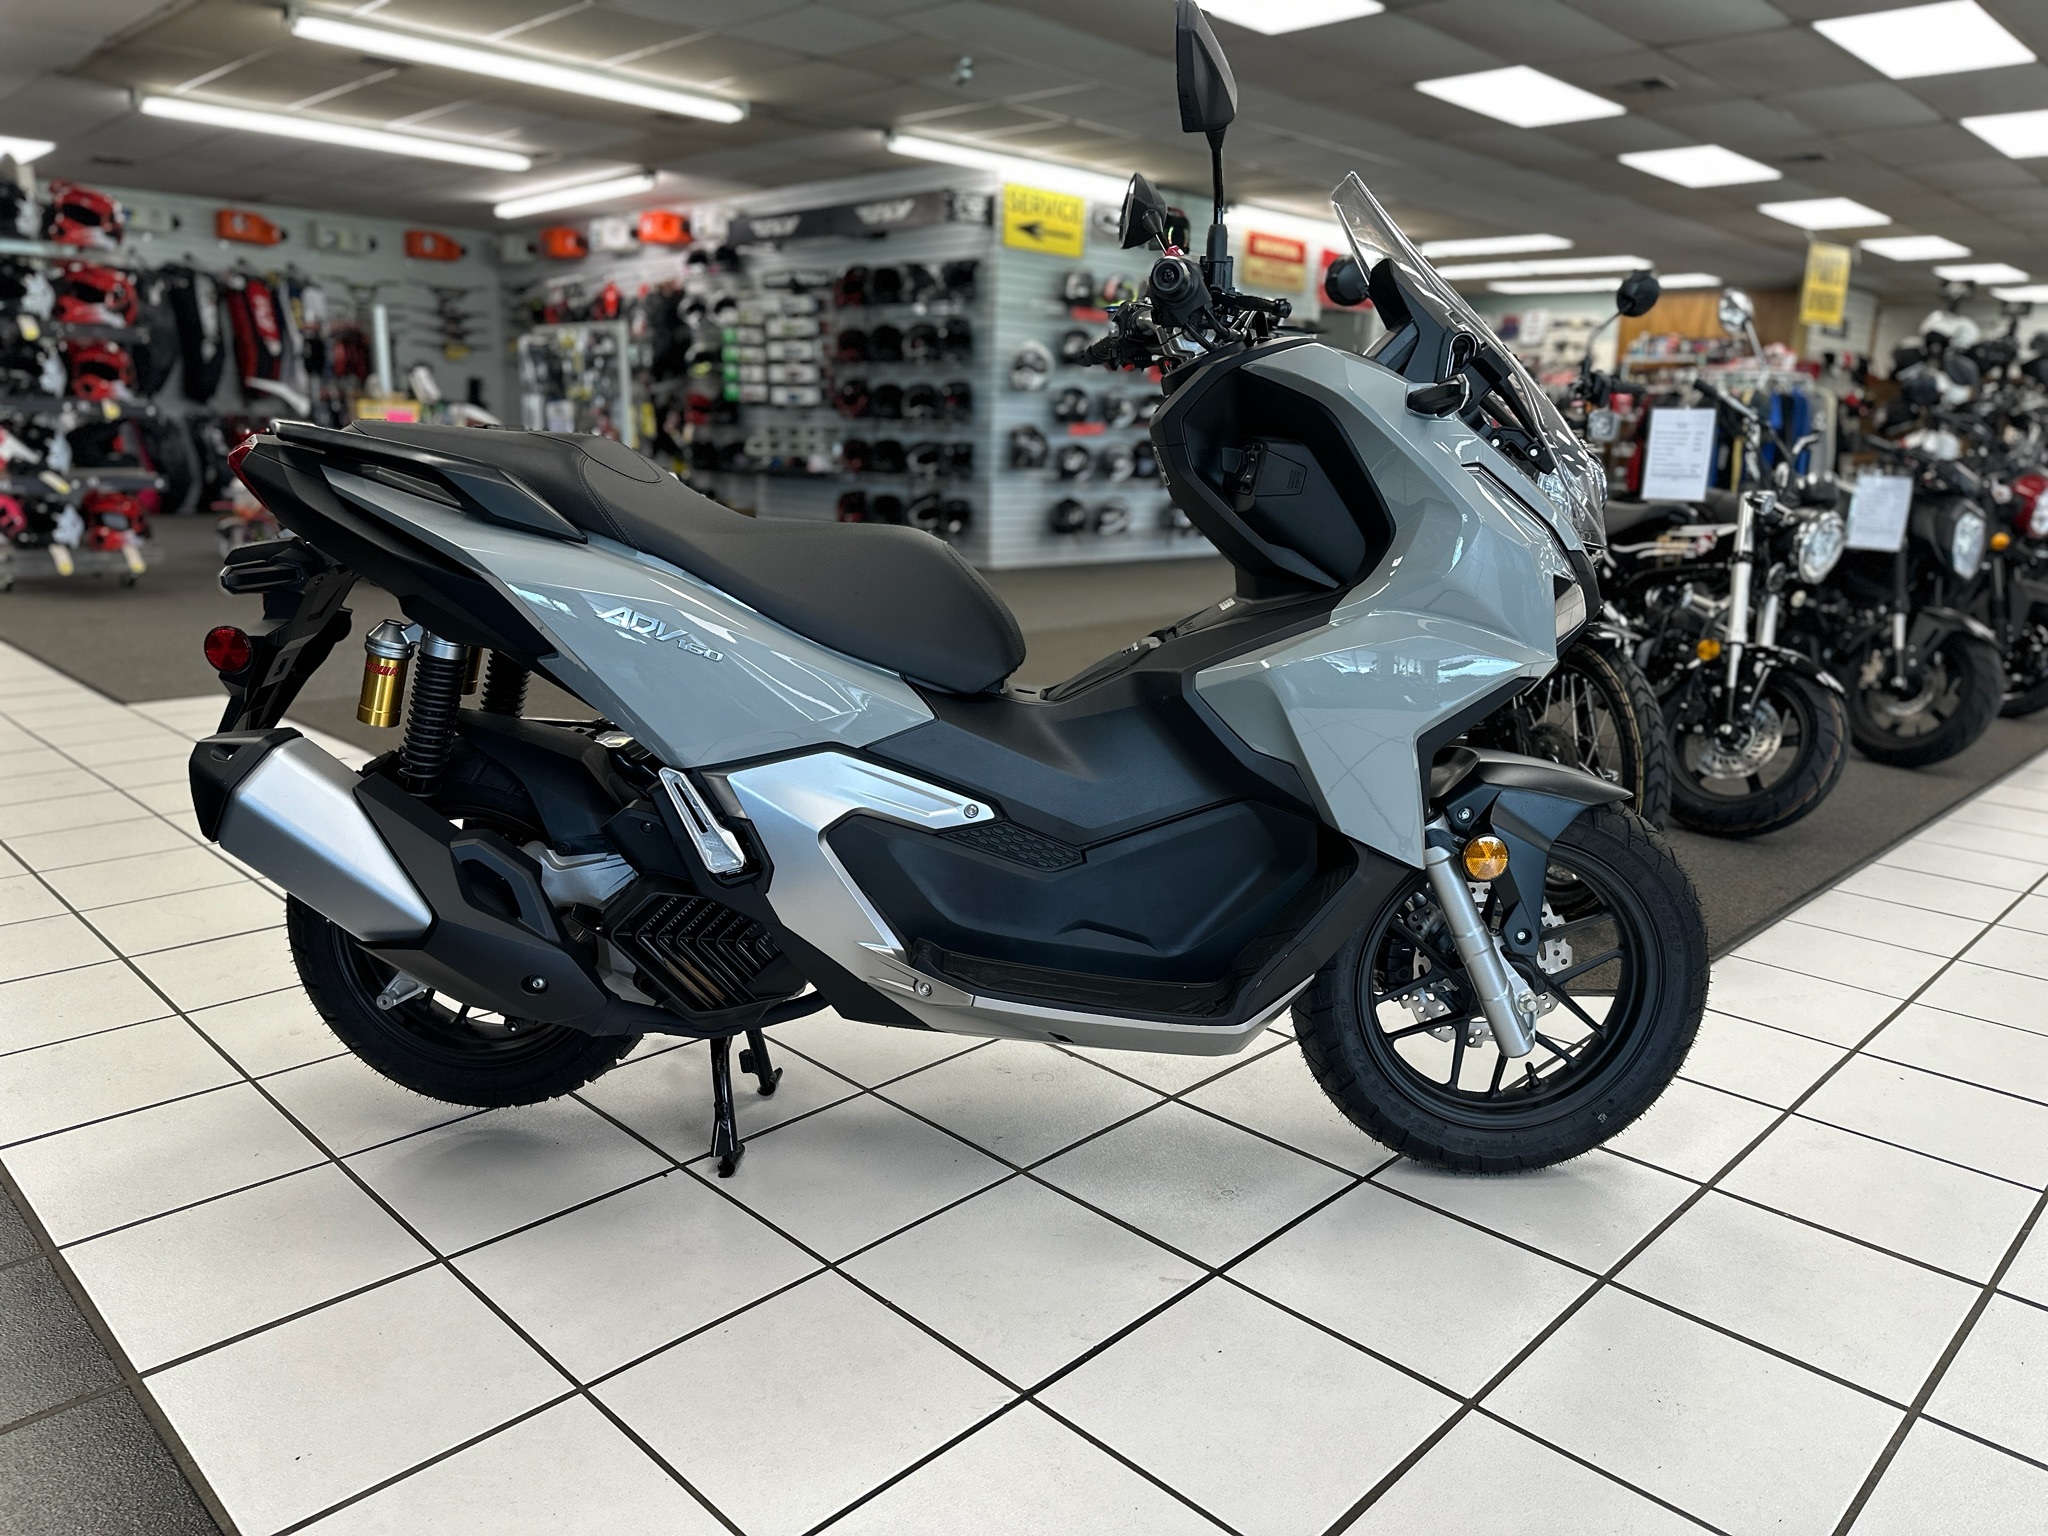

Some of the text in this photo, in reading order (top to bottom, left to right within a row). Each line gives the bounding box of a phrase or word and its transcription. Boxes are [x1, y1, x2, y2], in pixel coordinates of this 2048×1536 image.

[1008, 189, 1079, 223] SERVICE
[596, 606, 724, 663] ADV 160
[366, 661, 399, 676] HOWA
